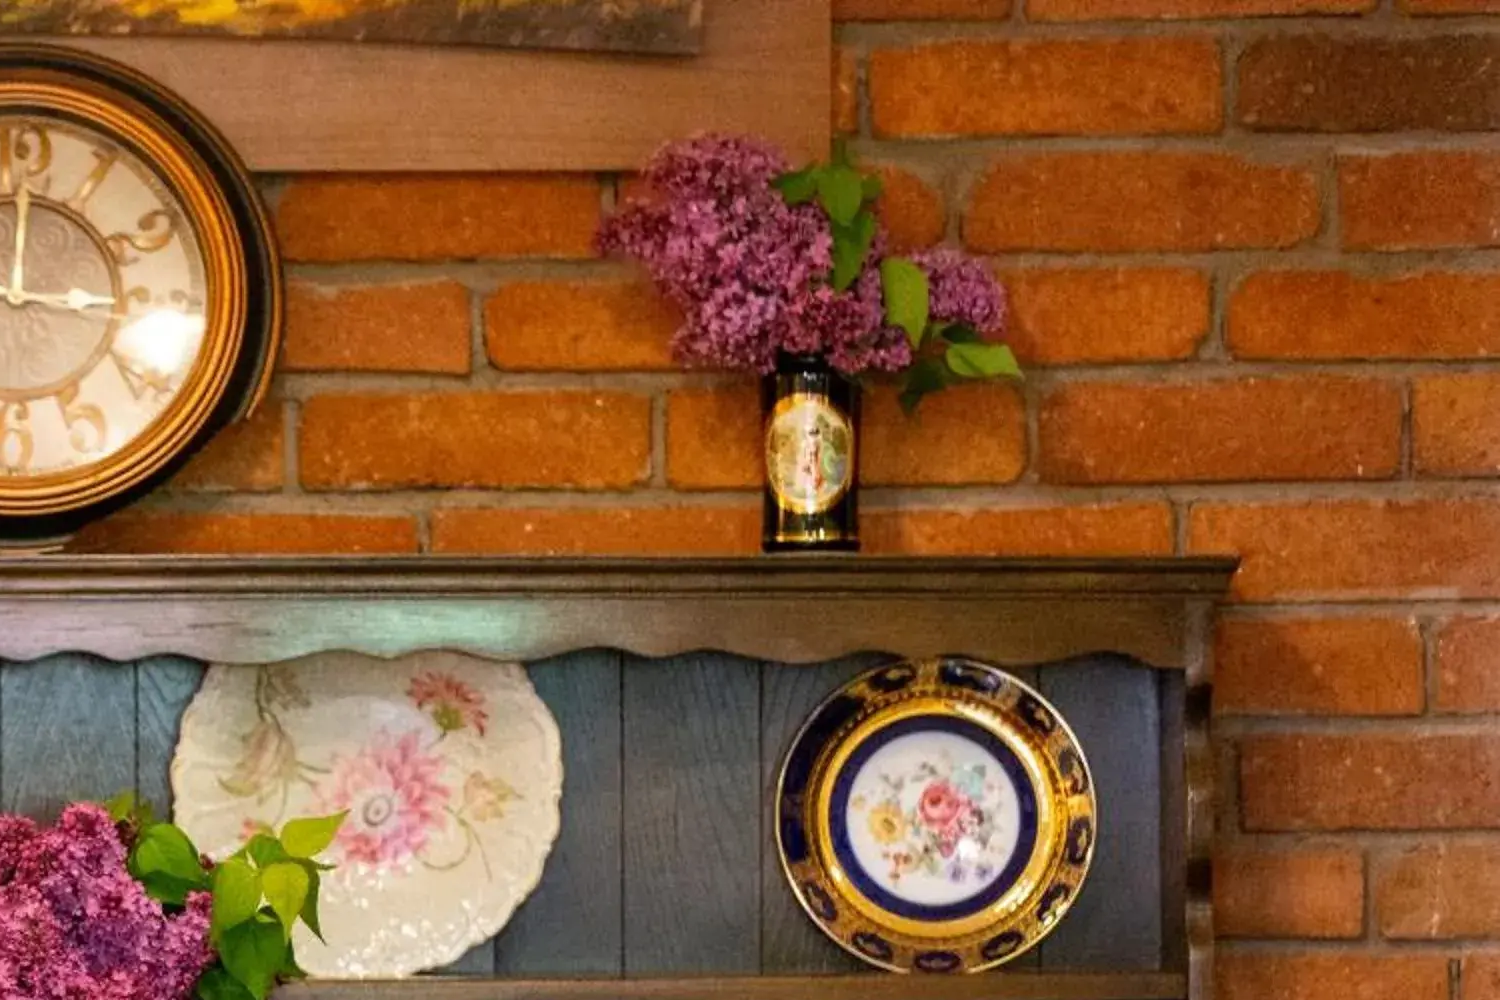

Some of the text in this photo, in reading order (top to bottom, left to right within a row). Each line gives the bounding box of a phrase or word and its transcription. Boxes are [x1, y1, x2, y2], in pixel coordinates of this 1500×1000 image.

[74, 148, 126, 207] 1
[104, 208, 177, 266] 2
[56, 380, 106, 454] 5
